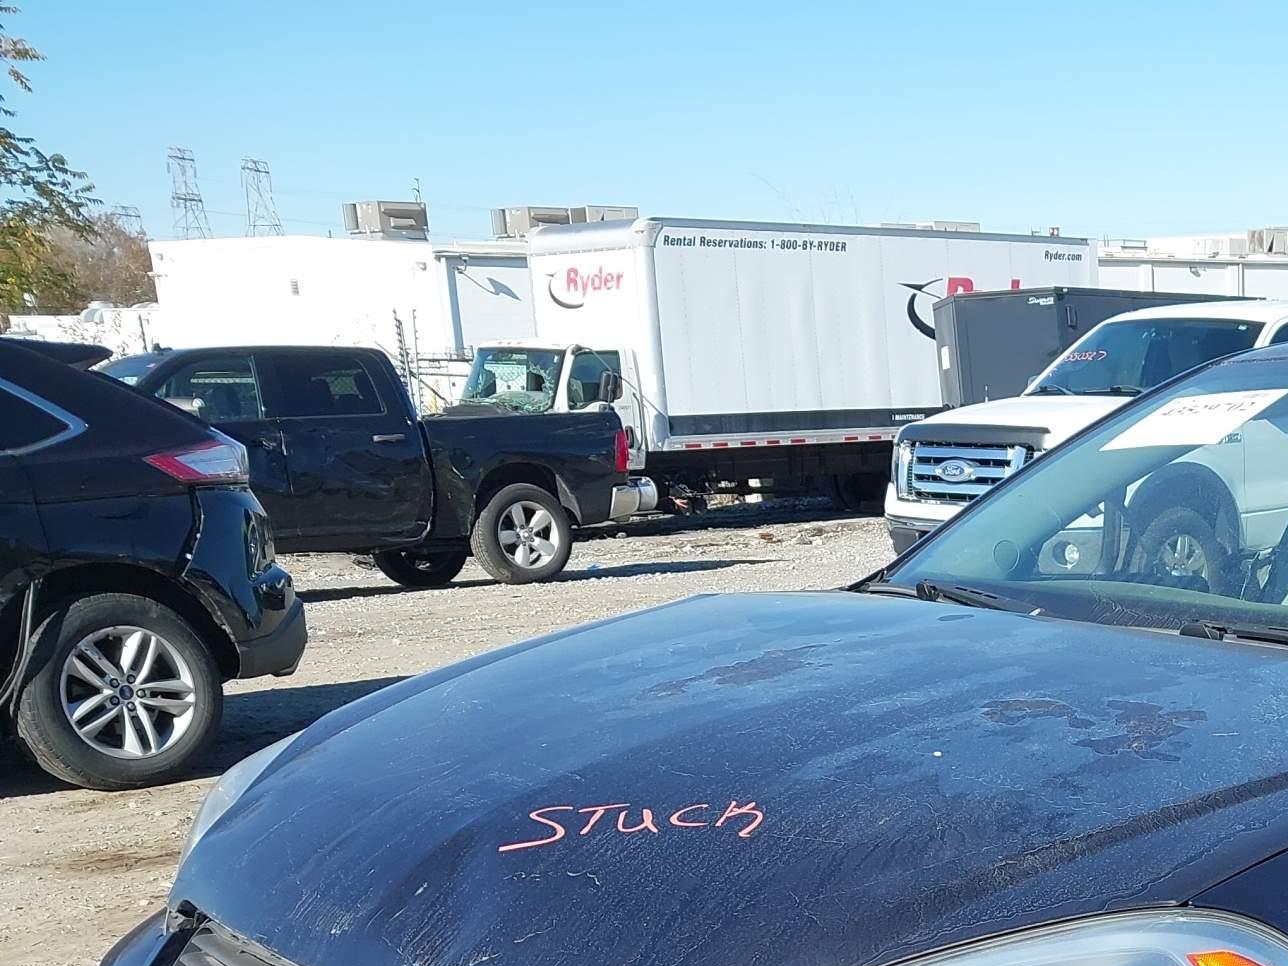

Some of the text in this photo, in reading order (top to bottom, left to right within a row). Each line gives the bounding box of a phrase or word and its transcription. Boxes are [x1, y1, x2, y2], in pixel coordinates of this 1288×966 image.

[663, 235, 847, 252] Rental Reservations: 1-800-BY-RYDER
[1044, 250, 1083, 262] Ryder.com
[566, 264, 624, 298] Ryder
[499, 801, 763, 852] STUCK
